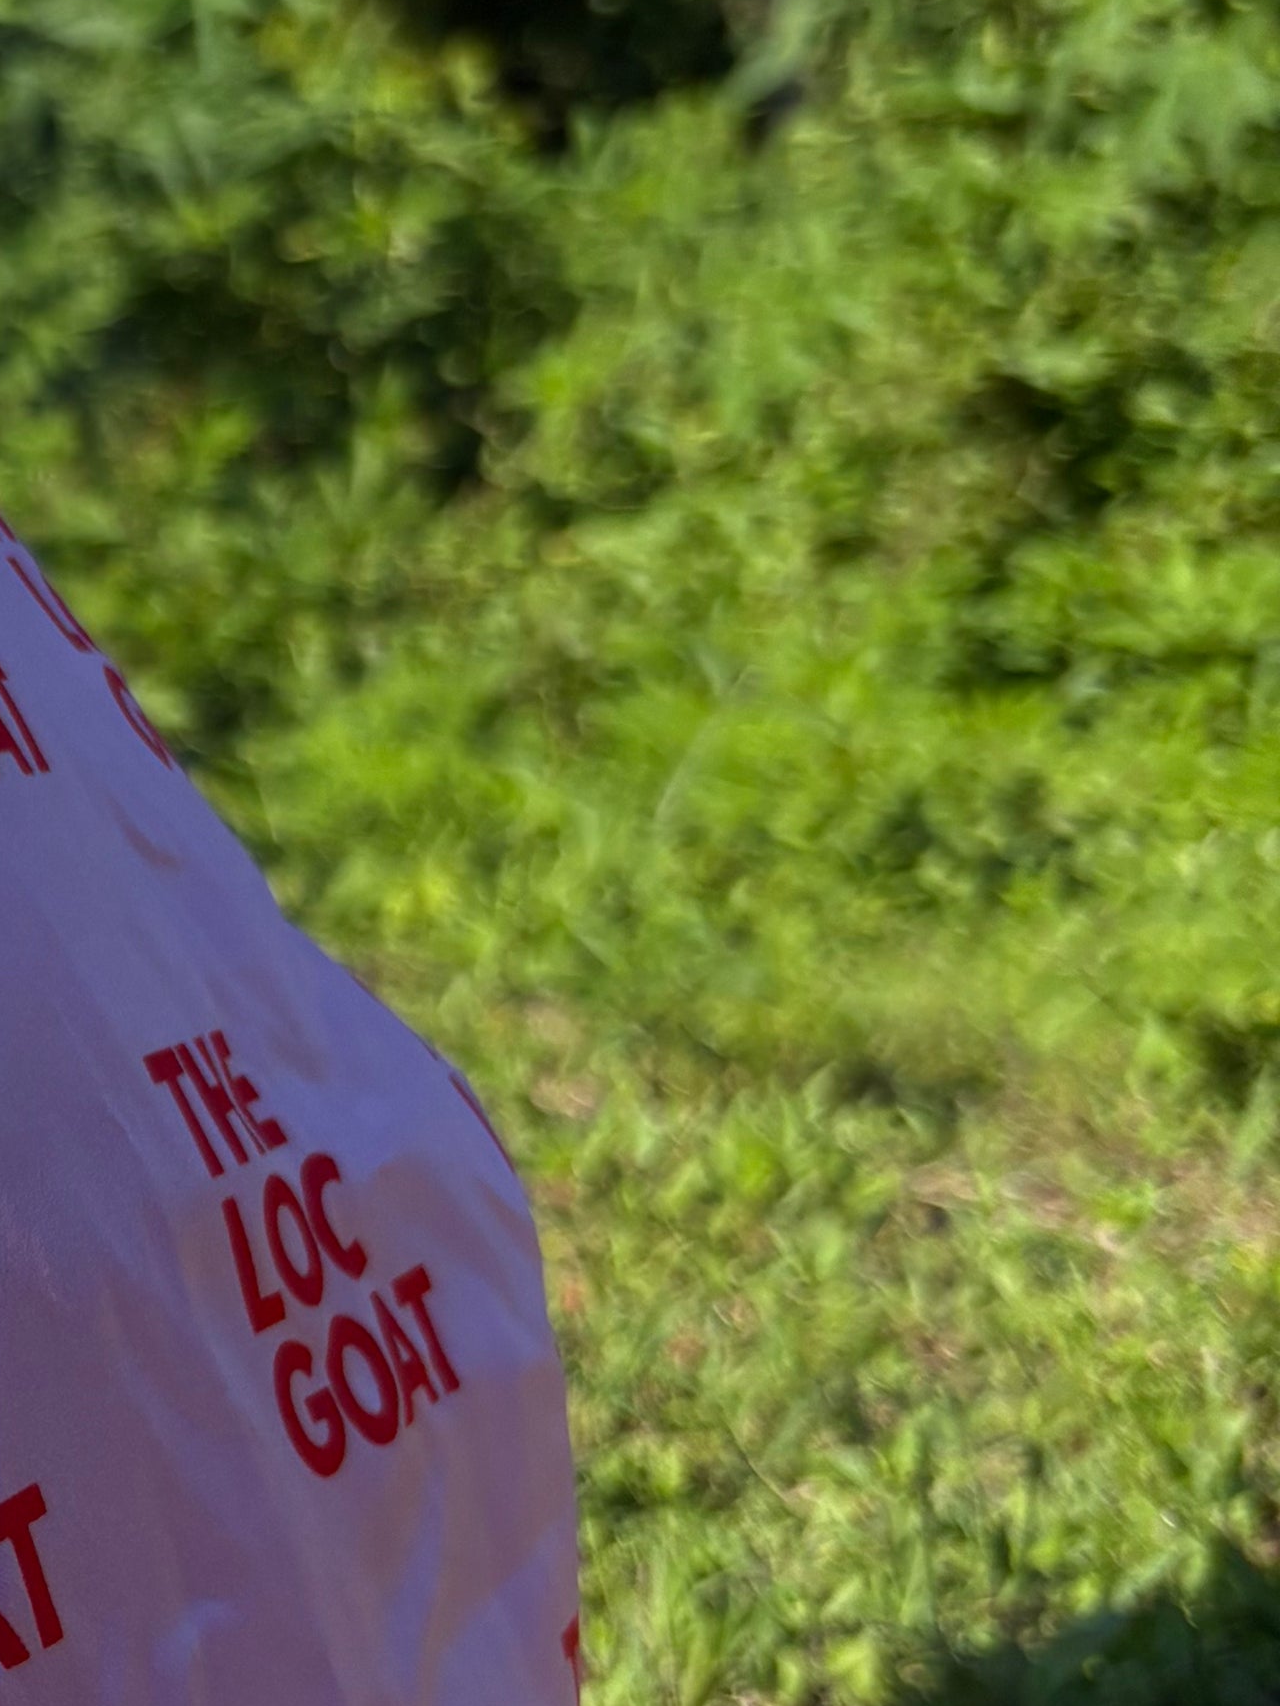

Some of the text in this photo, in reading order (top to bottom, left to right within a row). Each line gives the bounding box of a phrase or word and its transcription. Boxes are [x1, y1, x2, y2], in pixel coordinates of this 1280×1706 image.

[143, 1029, 288, 1178] THE
[222, 1153, 367, 1335] LOC
[273, 1264, 460, 1477] GOAT
